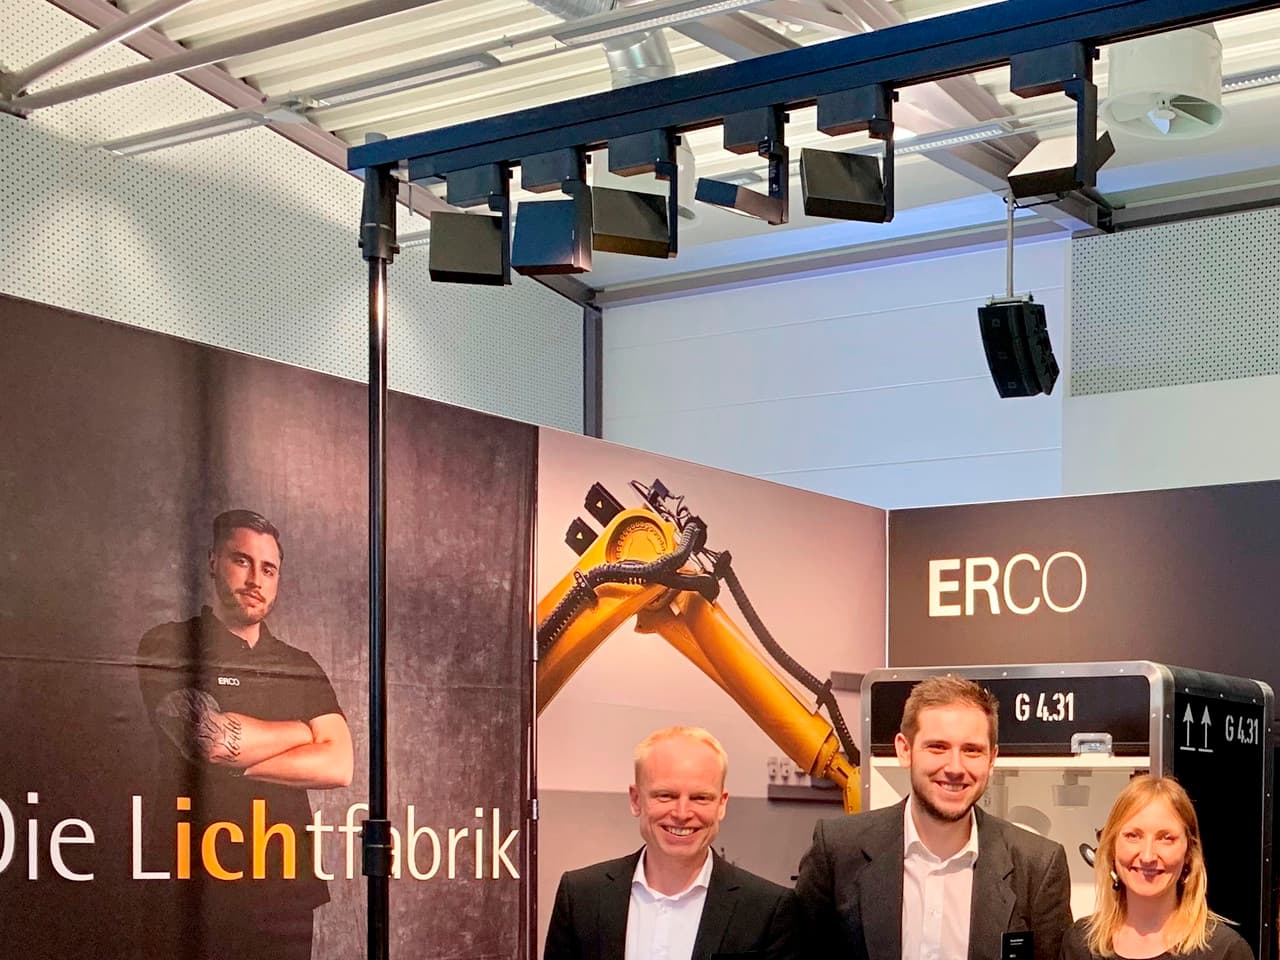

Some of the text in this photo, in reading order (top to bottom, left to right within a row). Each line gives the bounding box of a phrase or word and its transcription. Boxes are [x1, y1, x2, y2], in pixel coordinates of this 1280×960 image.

[929, 551, 1087, 617] ERCO
[218, 677, 240, 686] ERCO
[1015, 692, 1074, 721] G 4.31
[1225, 714, 1259, 745] G 4.31
